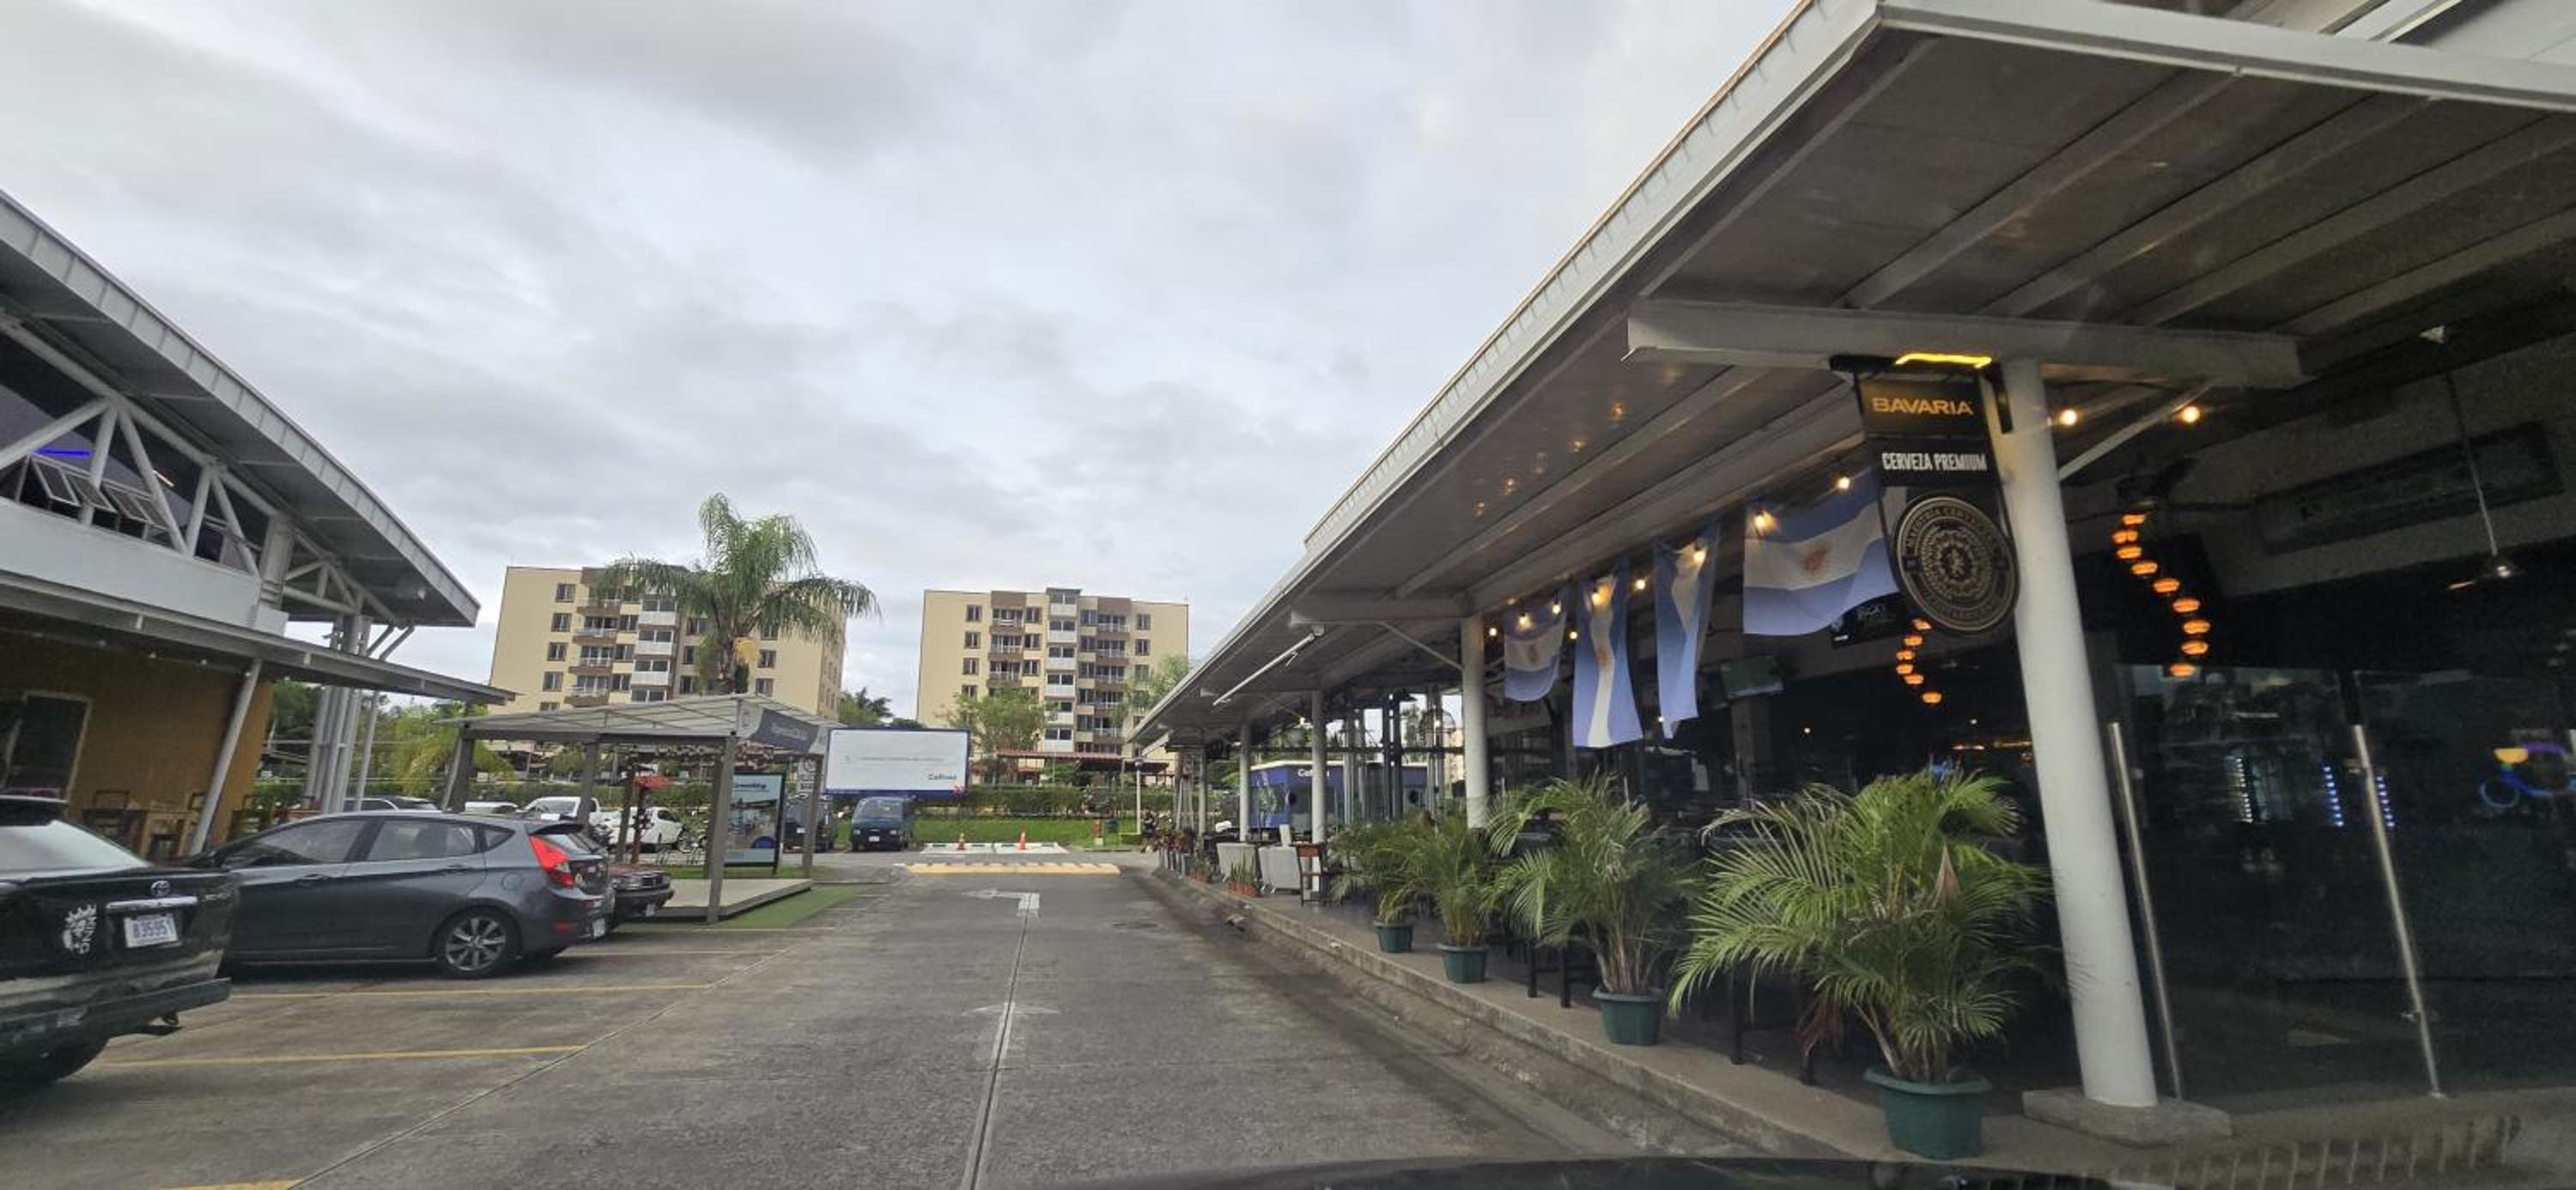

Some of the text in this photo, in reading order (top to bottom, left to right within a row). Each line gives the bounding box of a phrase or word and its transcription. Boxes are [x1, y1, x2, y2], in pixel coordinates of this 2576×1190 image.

[1872, 398, 1974, 415] BAVARIA
[1881, 452, 1988, 471] CERVEZA PREMIUM
